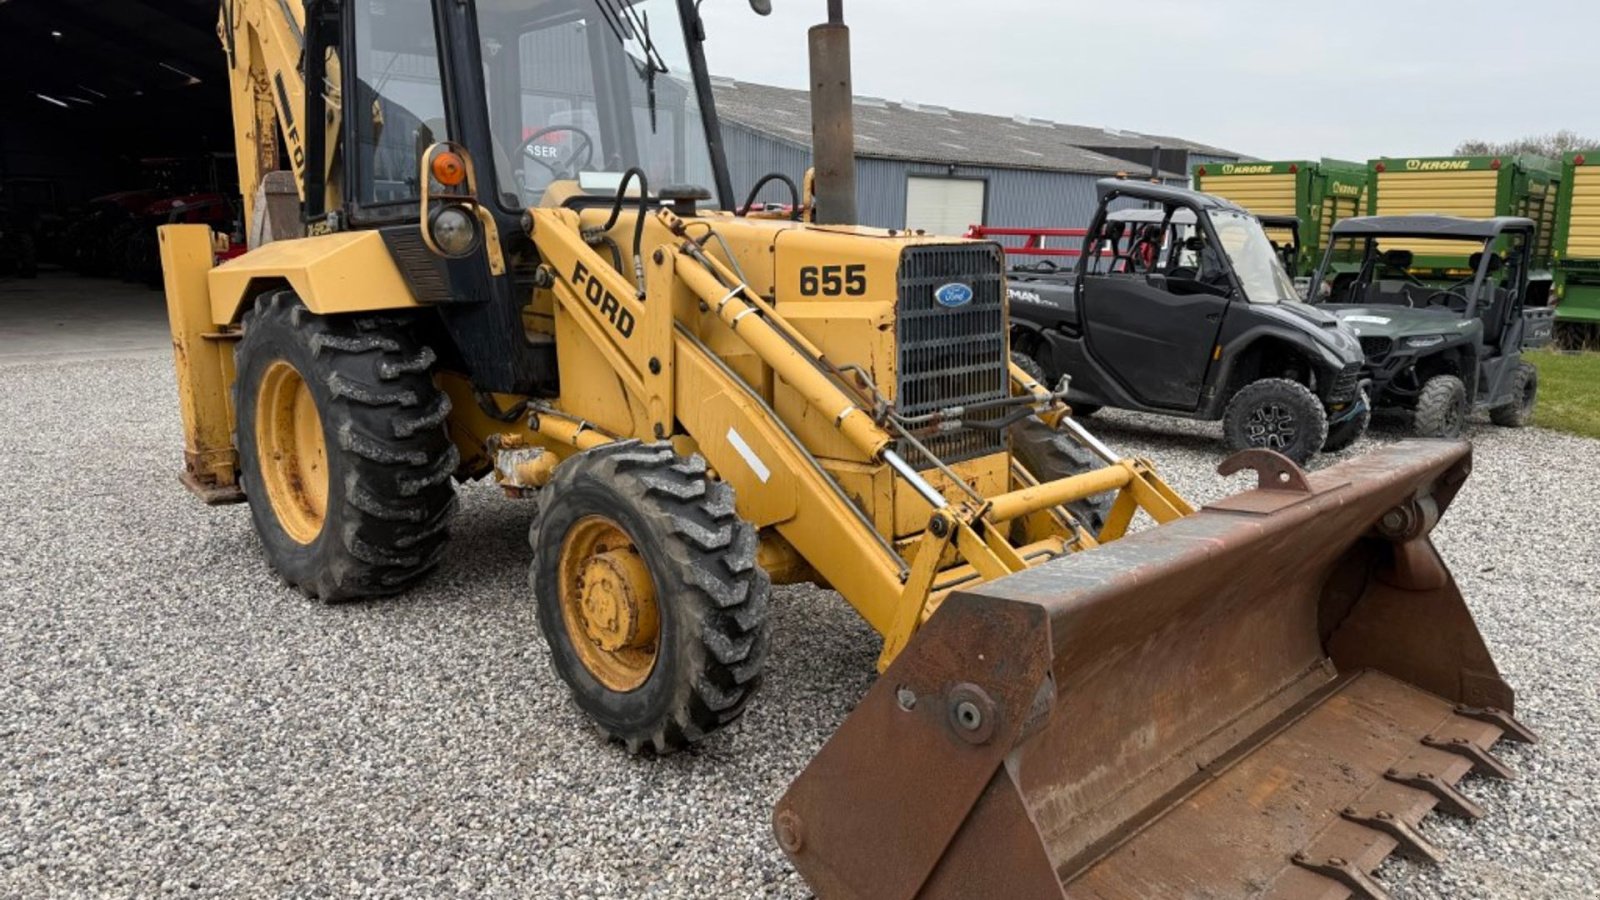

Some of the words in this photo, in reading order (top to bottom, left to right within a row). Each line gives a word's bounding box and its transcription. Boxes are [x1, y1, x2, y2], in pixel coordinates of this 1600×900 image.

[1234, 165, 1273, 174] KRONE
[1420, 161, 1470, 170] KRONE
[800, 264, 866, 296] 655
[572, 260, 635, 339] FORD
